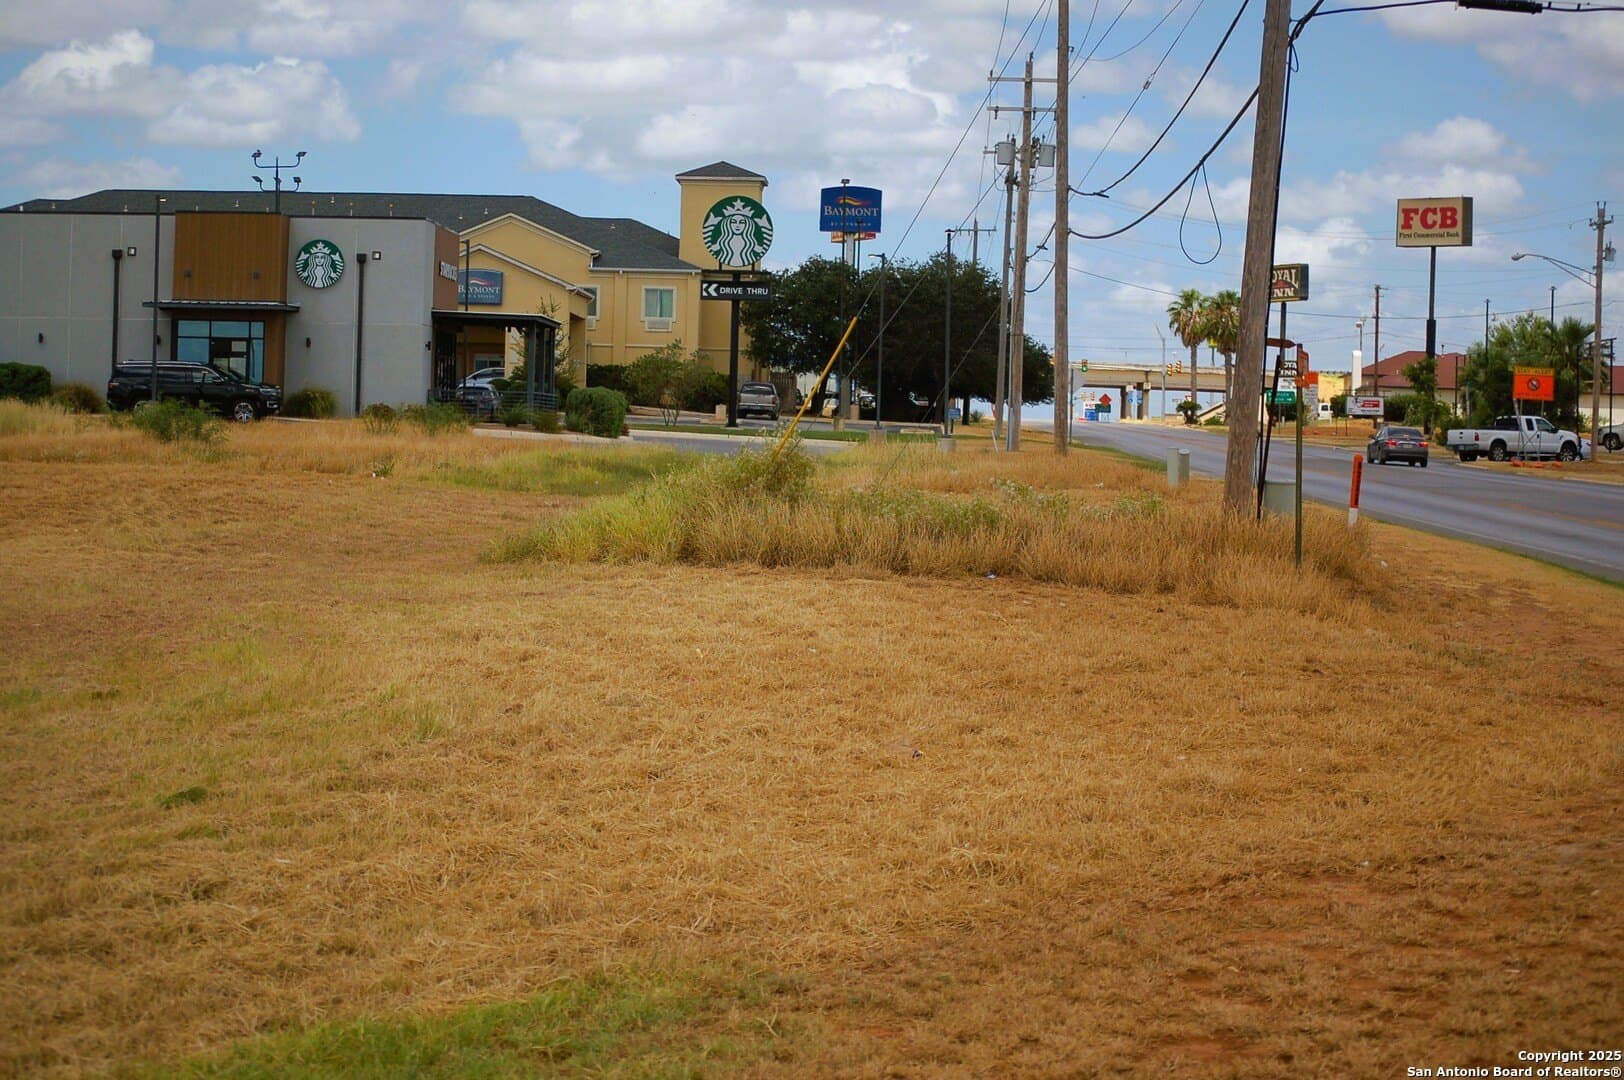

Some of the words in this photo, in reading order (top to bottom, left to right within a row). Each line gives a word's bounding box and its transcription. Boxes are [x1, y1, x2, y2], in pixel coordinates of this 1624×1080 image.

[824, 205, 879, 217] BAYMONT
[1401, 206, 1458, 230] FCB
[1413, 231, 1445, 239] Commercial
[1272, 269, 1299, 289] OYAL
[719, 286, 743, 295] DRIVE
[746, 286, 769, 296] THRU
[1273, 287, 1294, 297] NN
